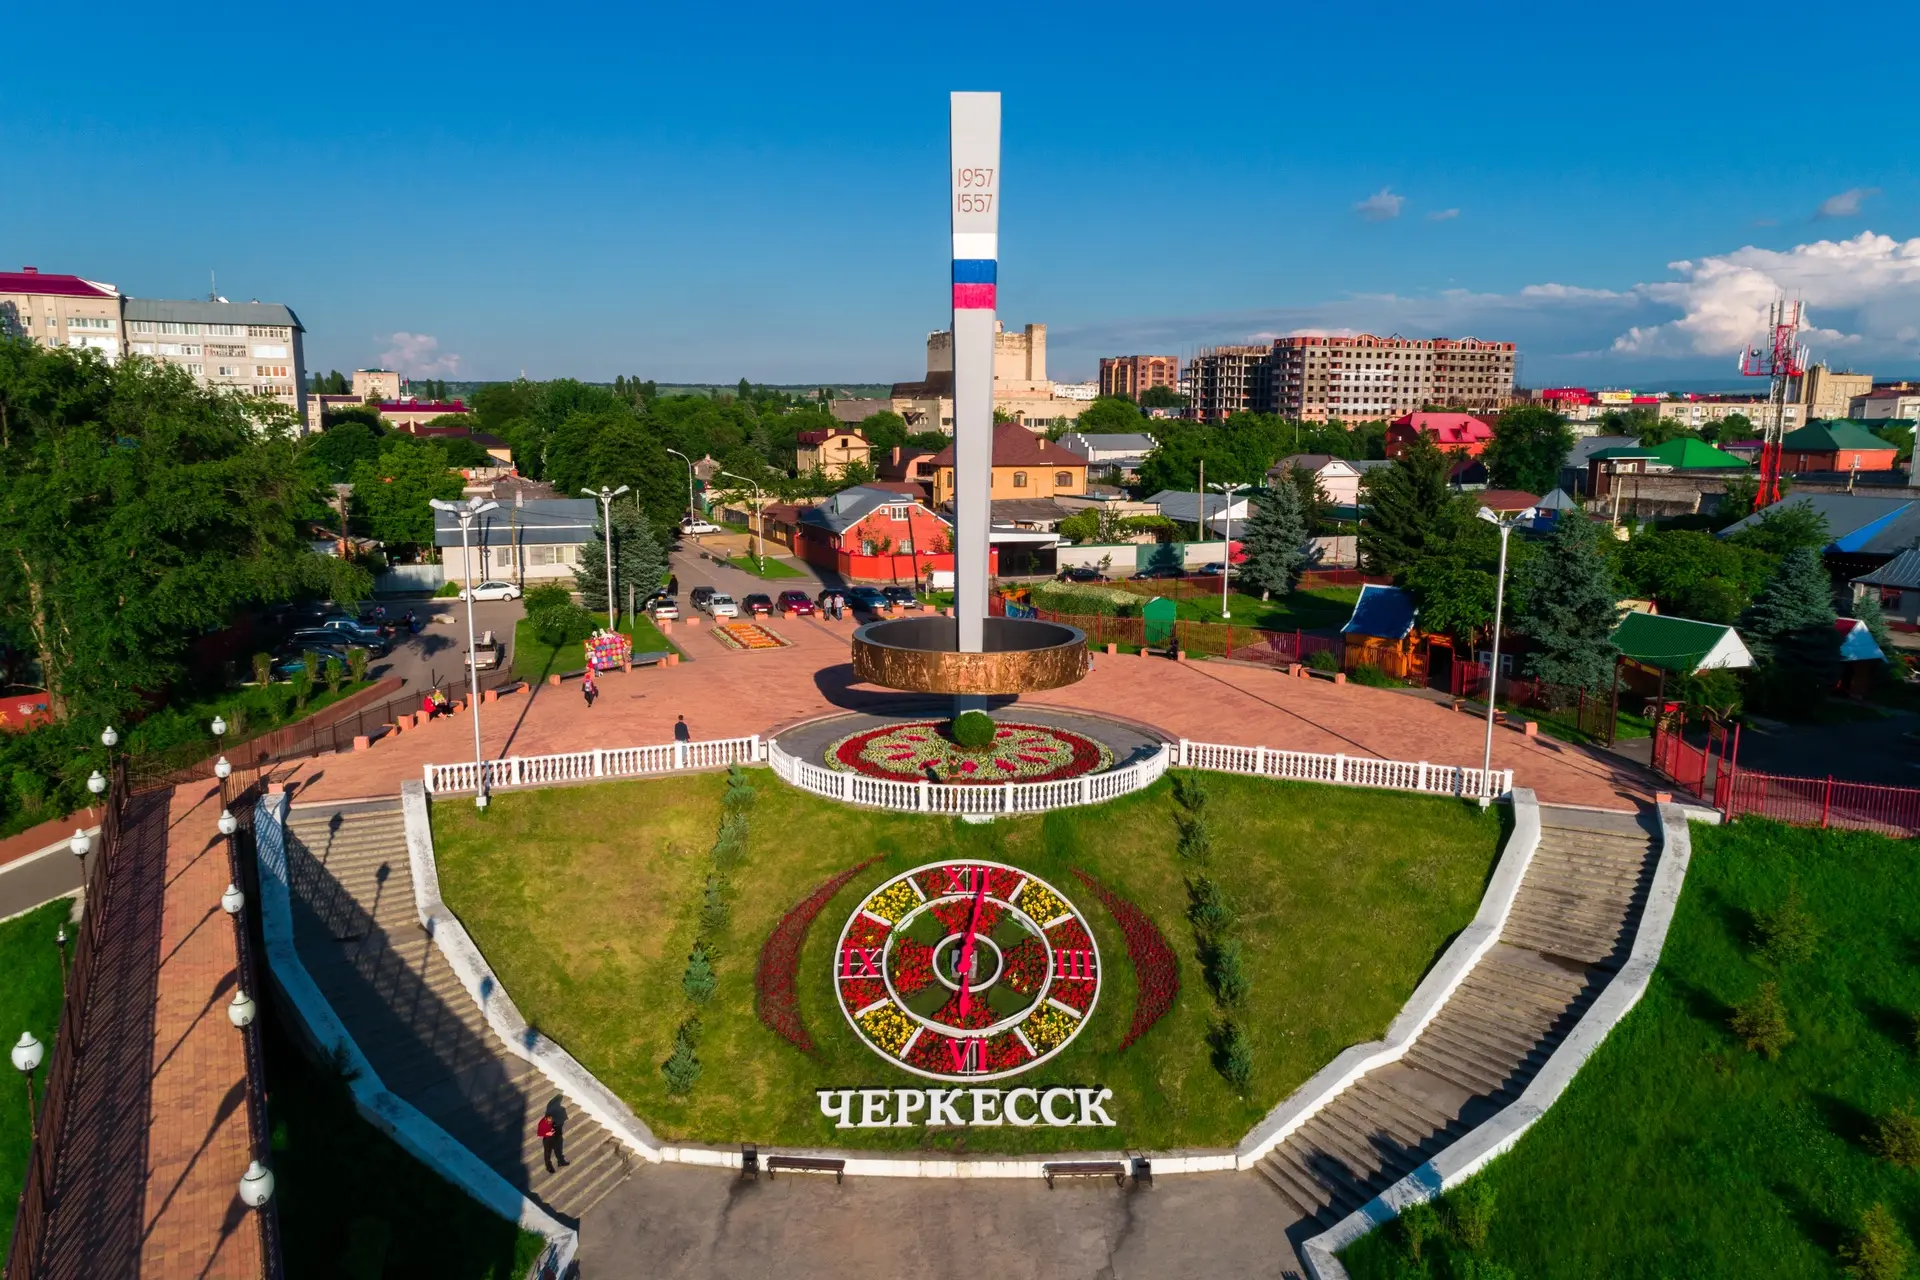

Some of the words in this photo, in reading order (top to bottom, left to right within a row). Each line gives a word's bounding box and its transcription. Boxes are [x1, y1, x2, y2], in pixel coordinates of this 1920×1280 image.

[957, 168, 994, 188] 1957
[957, 193, 993, 213] 1557
[942, 865, 993, 894] XII
[840, 946, 882, 978] IX
[1053, 948, 1094, 980] III
[945, 1037, 989, 1073] VI
[816, 1087, 1117, 1128] ЧЕРКЕССК
